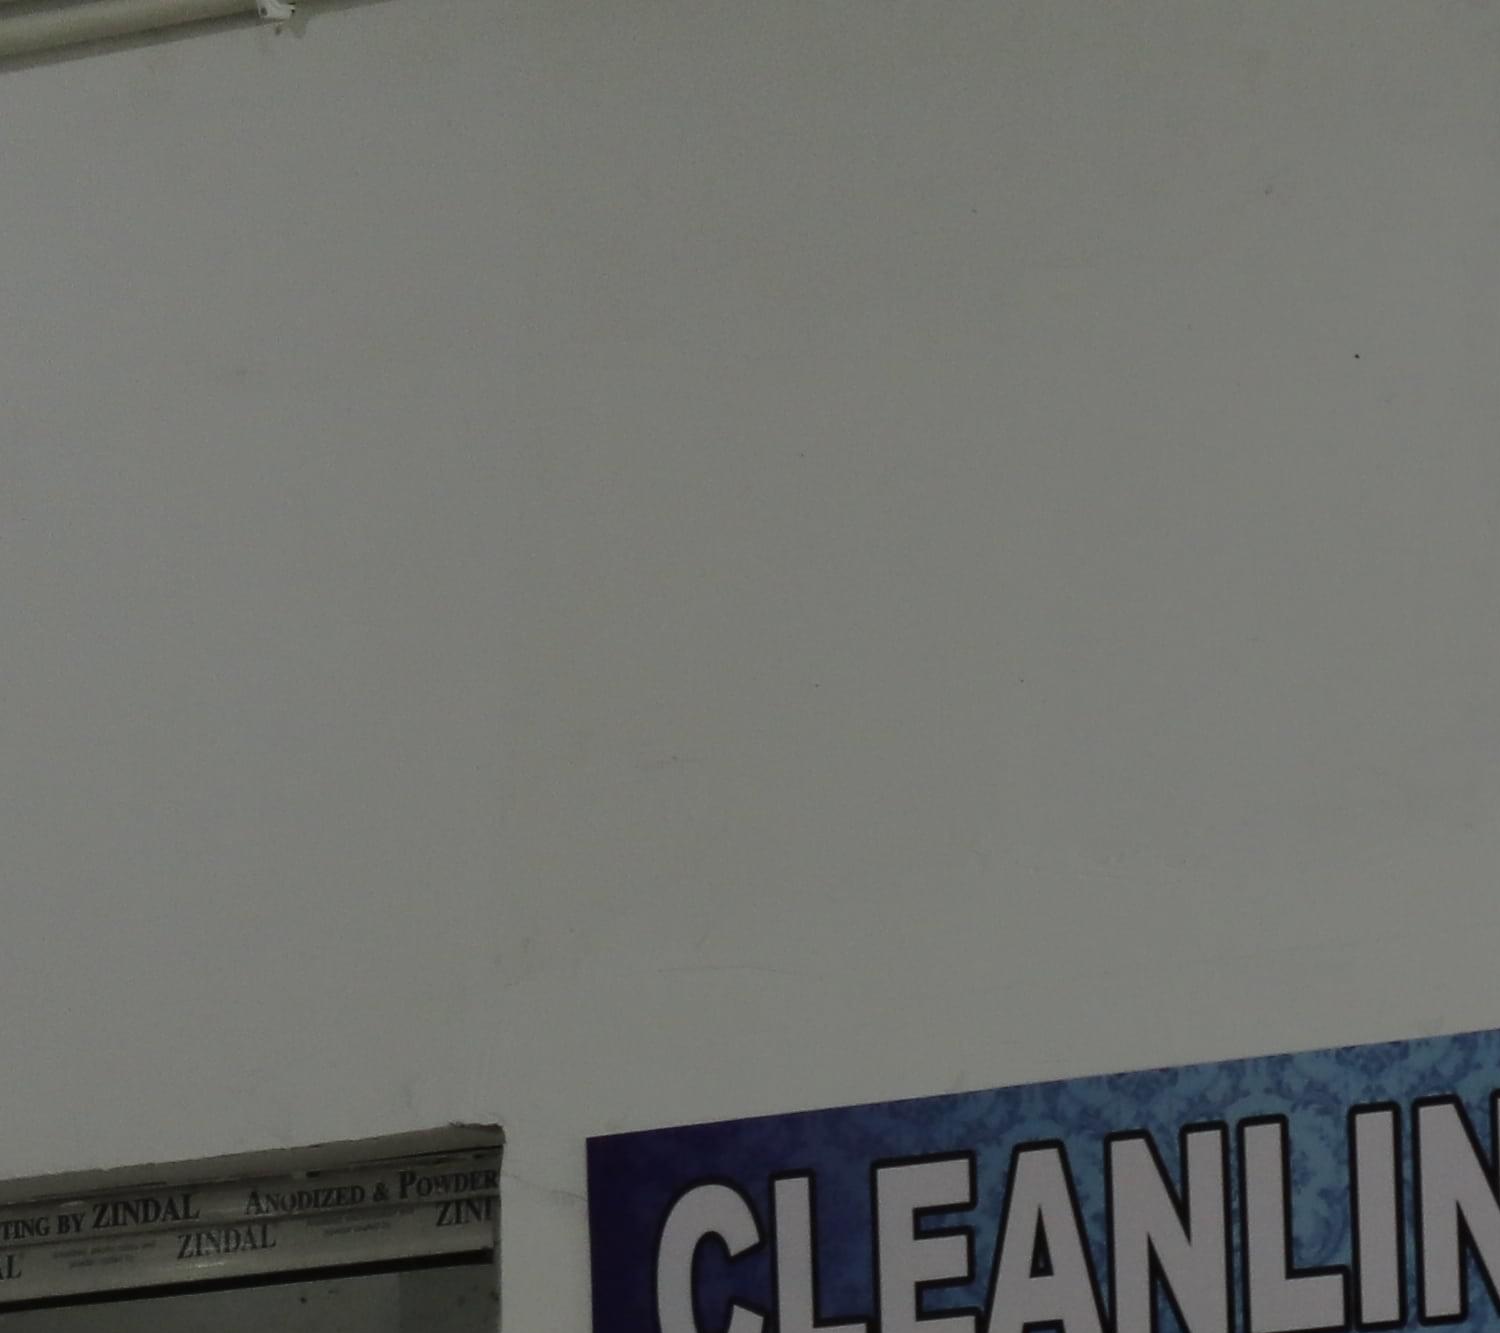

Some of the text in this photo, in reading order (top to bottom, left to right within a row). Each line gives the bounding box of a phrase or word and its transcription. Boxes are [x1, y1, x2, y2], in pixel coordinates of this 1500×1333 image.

[57, 1212, 85, 1234] BY
[93, 1193, 200, 1229] ZINDAL
[373, 1182, 389, 1202] &
[177, 1223, 276, 1260] ZINDAL
